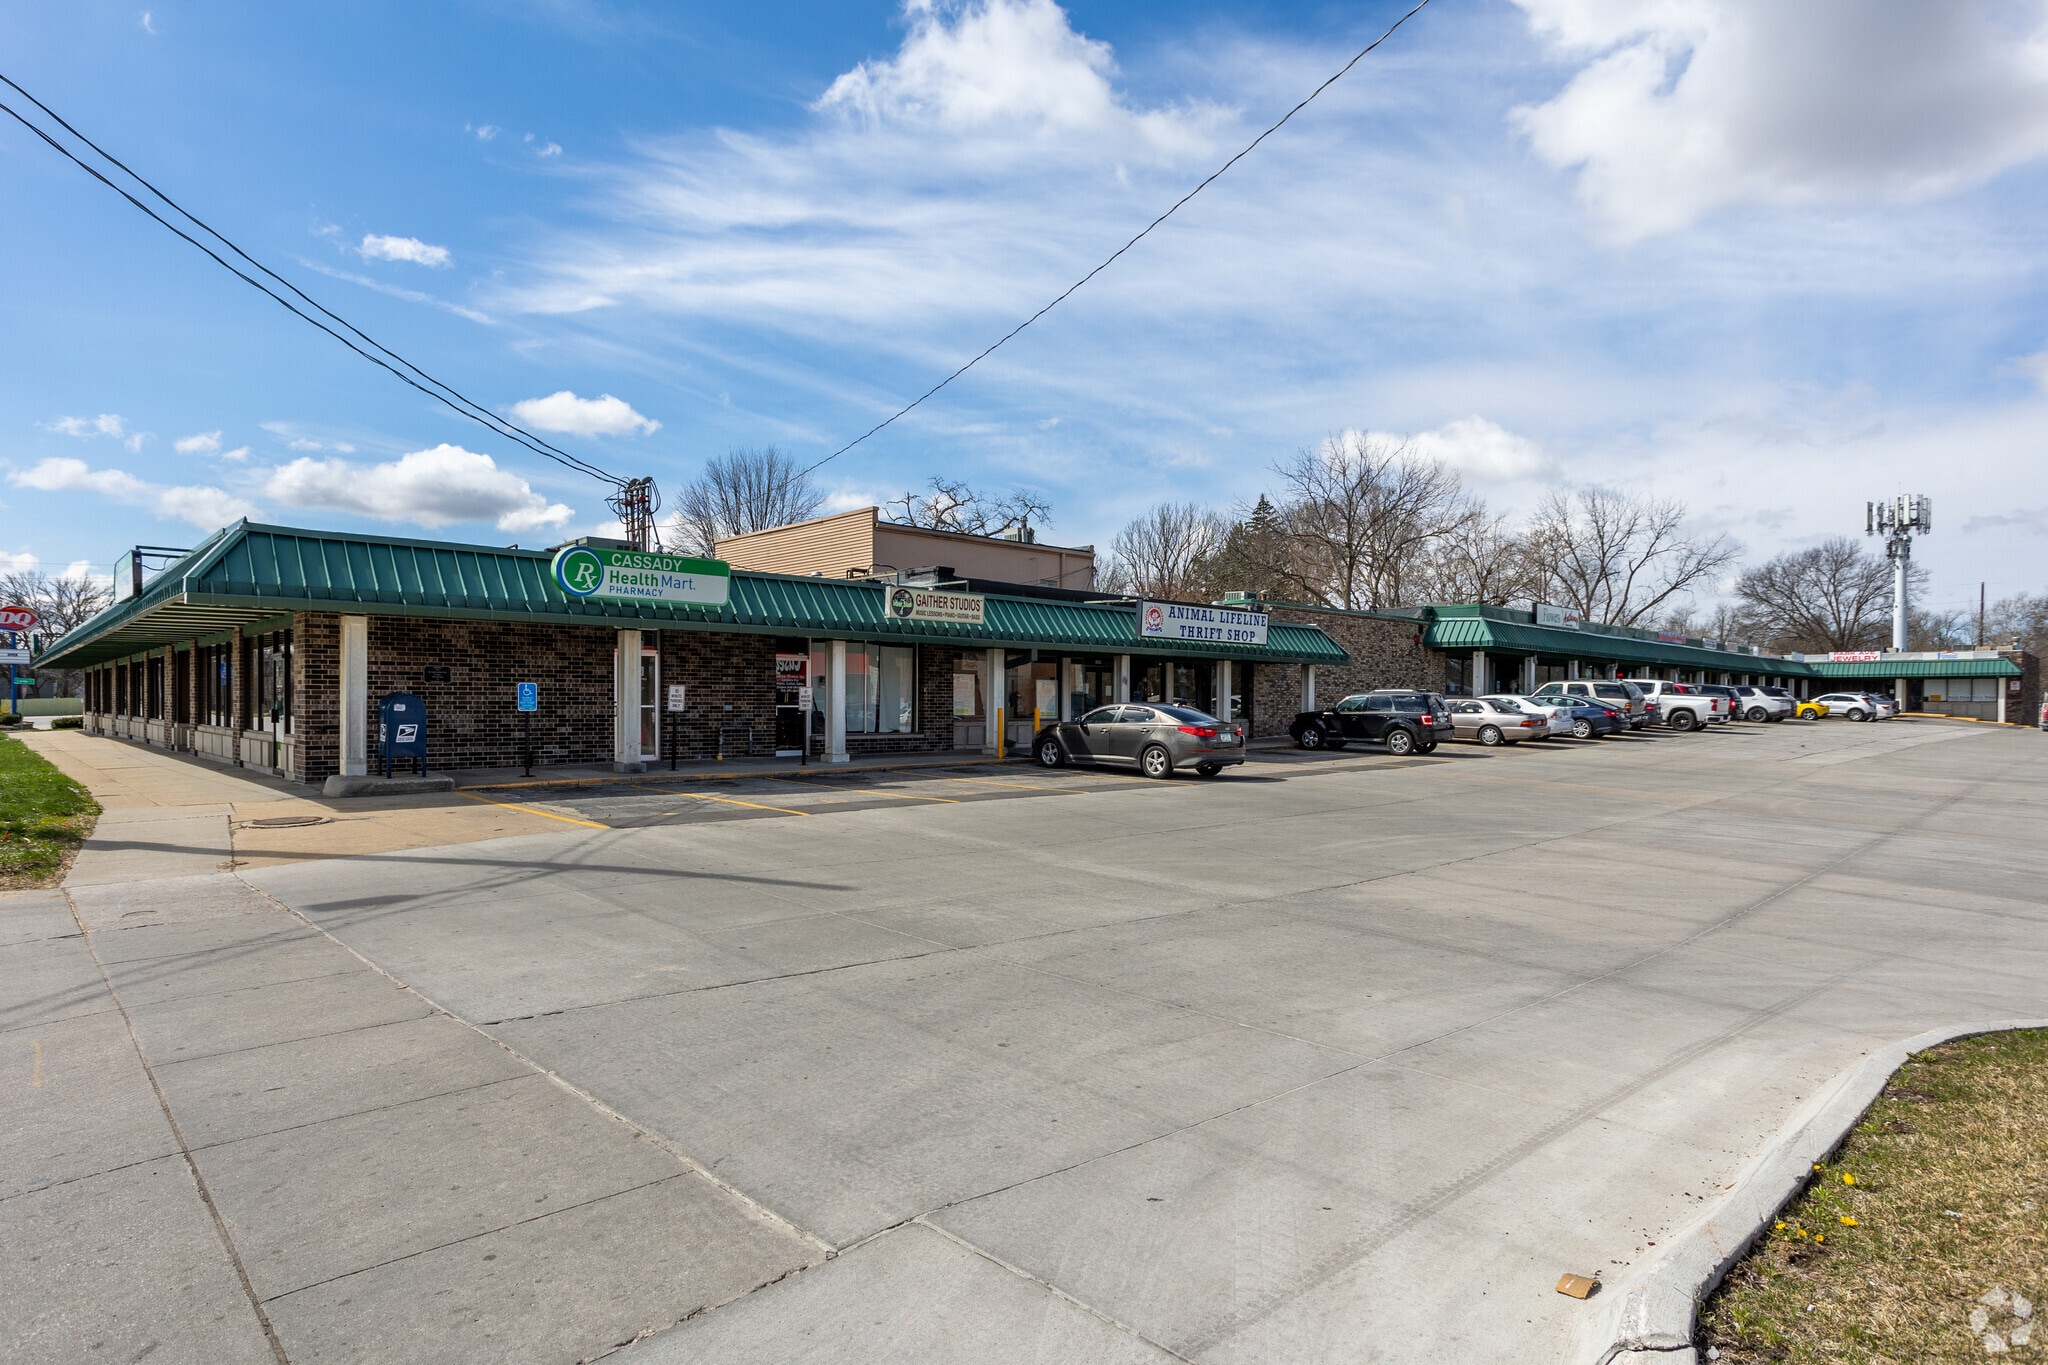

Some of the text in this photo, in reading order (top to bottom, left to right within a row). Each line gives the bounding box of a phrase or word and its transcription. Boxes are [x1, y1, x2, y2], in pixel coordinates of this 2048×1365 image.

[611, 553, 683, 572] CASSADY
[609, 570, 659, 587] Health
[609, 586, 664, 597] PHARMACY
[915, 593, 981, 612] GAITHER STUDIOS
[0, 611, 32, 627] DQ
[926, 610, 943, 618] LESSONS
[944, 611, 956, 619] PIANO
[1168, 606, 1215, 622] ANIMAL
[1219, 611, 1267, 627] LIFELINE
[1179, 625, 1256, 642] THRIFT SHOP
